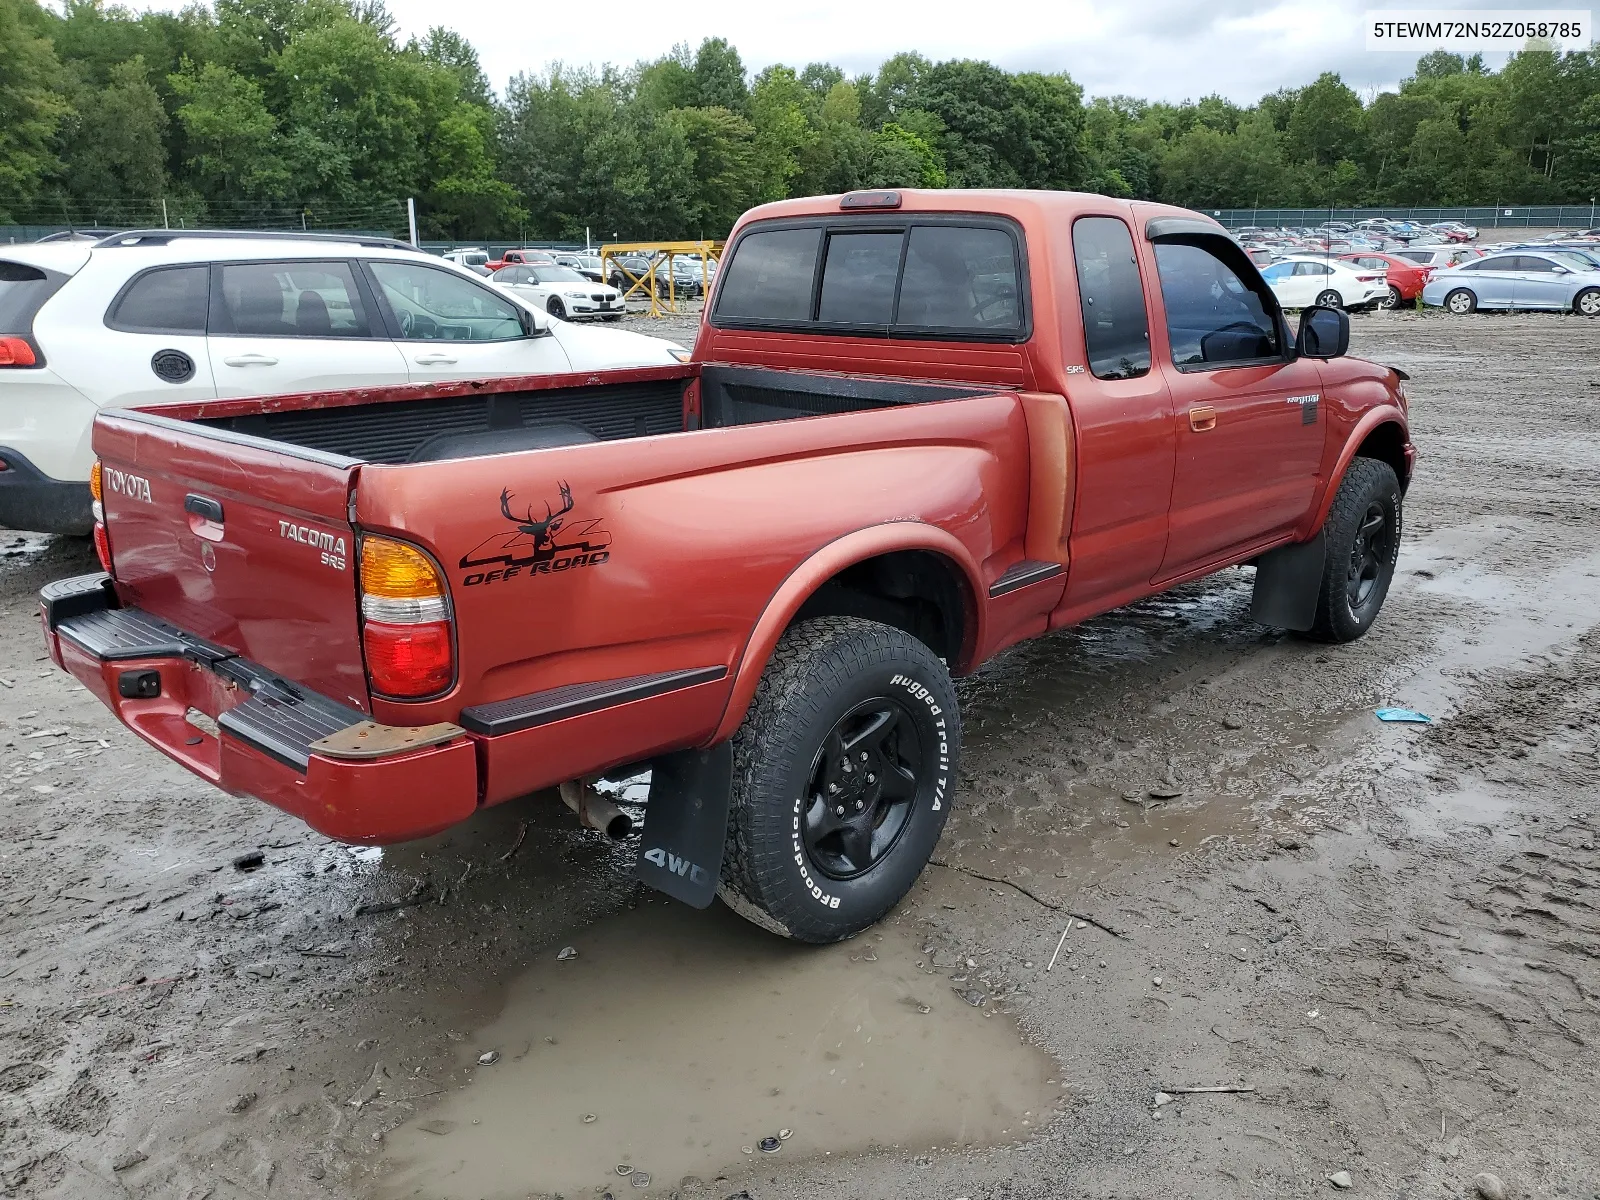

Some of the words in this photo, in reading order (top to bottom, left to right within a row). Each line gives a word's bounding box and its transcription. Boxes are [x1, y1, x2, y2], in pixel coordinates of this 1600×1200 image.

[104, 467, 151, 503] TOYOTA
[278, 520, 346, 556] TACOMA
[320, 552, 346, 571] SR5
[463, 565, 522, 586] OFF
[529, 551, 610, 576] ROAD
[889, 674, 943, 716] Rugged
[935, 717, 949, 771] Trail
[931, 777, 947, 811] T/A
[643, 847, 712, 888] 4WD
[791, 798, 841, 909] BFGoodrich
